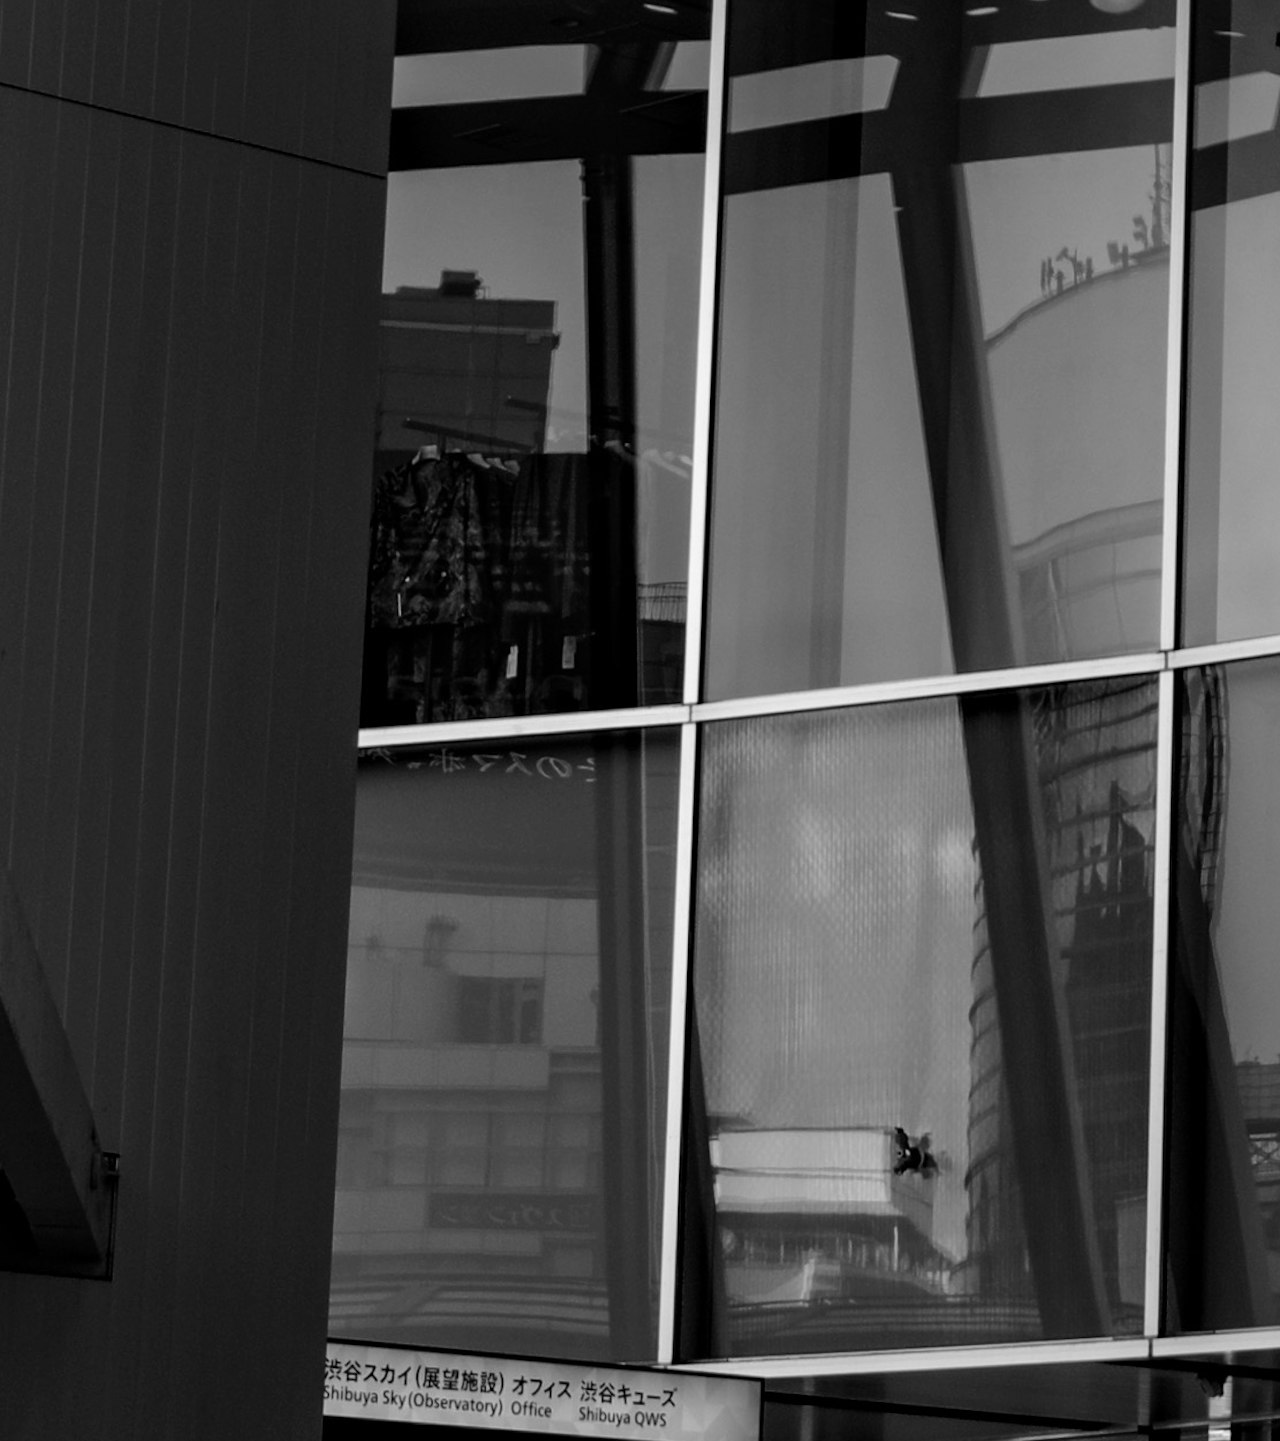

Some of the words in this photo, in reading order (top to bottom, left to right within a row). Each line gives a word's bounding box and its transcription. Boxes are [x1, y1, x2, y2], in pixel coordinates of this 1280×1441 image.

[323, 1385, 379, 1407] Shibuya
[511, 1401, 552, 1418] Office
[579, 1406, 631, 1427] Shibuya
[634, 1411, 668, 1427] QWS
[512, 1375, 572, 1399] オフィス
[580, 1380, 679, 1408] 渋谷キューズ
